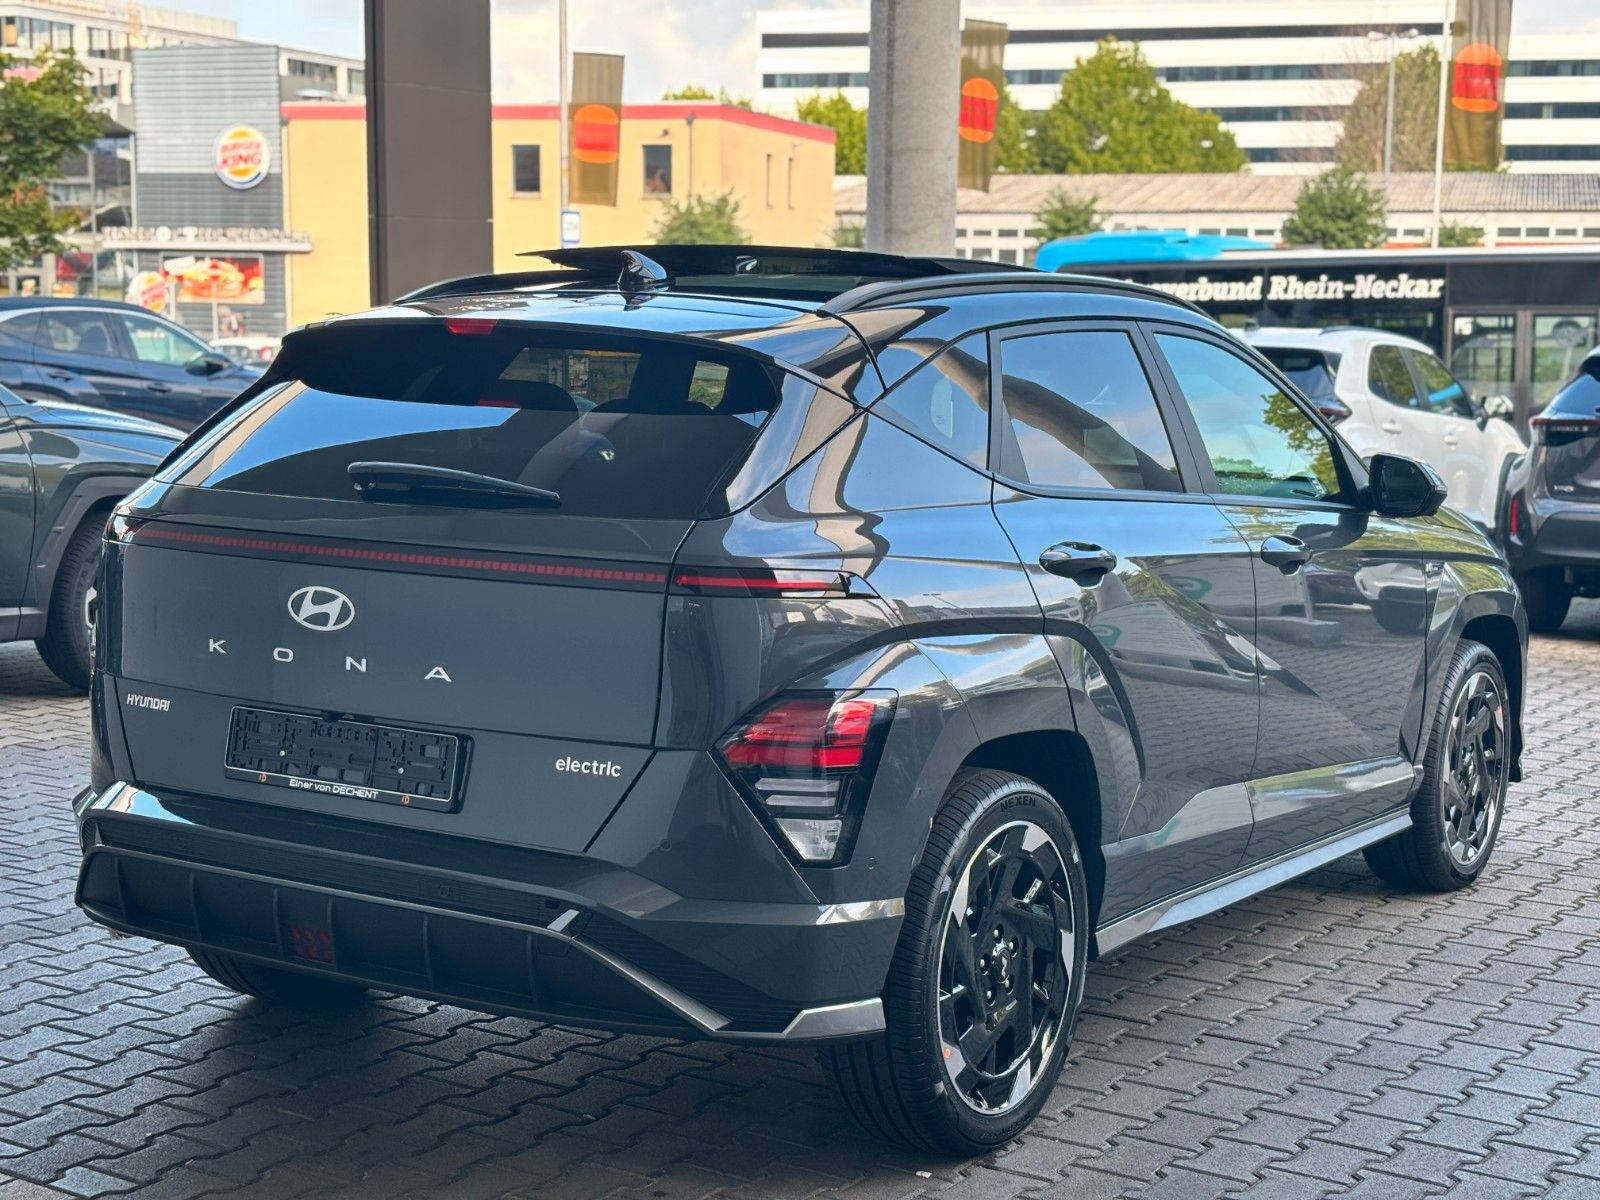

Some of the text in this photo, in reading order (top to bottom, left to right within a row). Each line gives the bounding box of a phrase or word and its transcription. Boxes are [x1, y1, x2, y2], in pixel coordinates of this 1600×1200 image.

[219, 153, 262, 169] KING
[1266, 273, 1445, 300] Rhein-Neckar
[126, 693, 171, 712] HYUNDAI
[555, 756, 622, 777] electric
[289, 778, 379, 800] Einer von DECHENT
[1000, 795, 1036, 812] NEXEN
